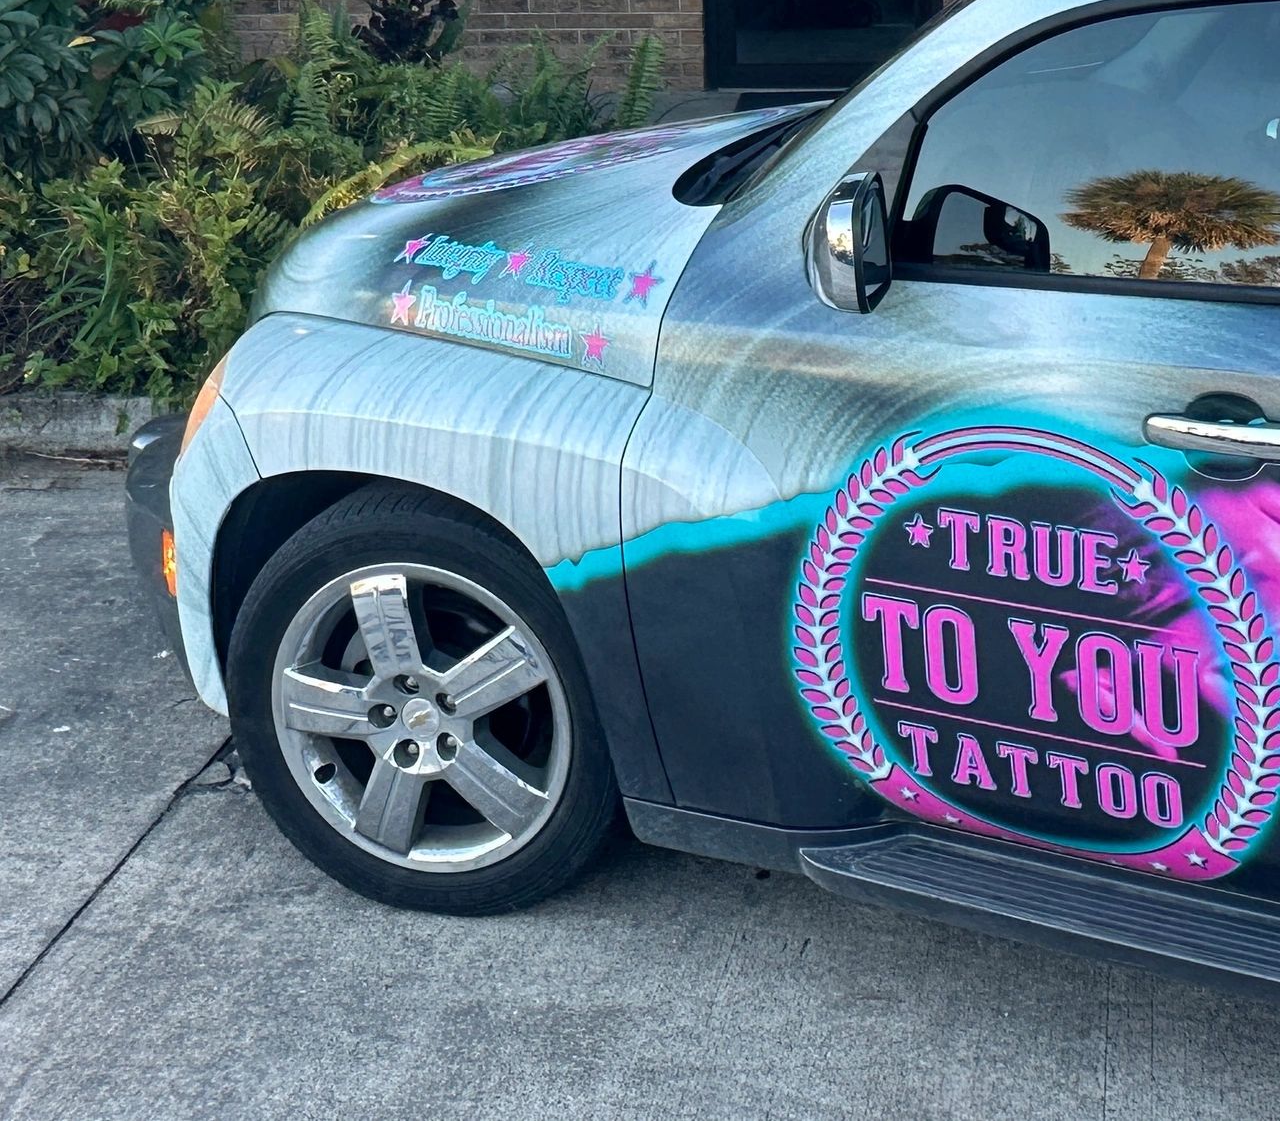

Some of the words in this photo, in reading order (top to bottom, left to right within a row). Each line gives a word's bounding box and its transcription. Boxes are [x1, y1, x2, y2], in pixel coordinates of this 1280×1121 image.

[937, 506, 1120, 596] TRUE
[862, 593, 979, 706] TO
[1007, 618, 1200, 748] YOU
[898, 720, 1185, 829] TATTOO
